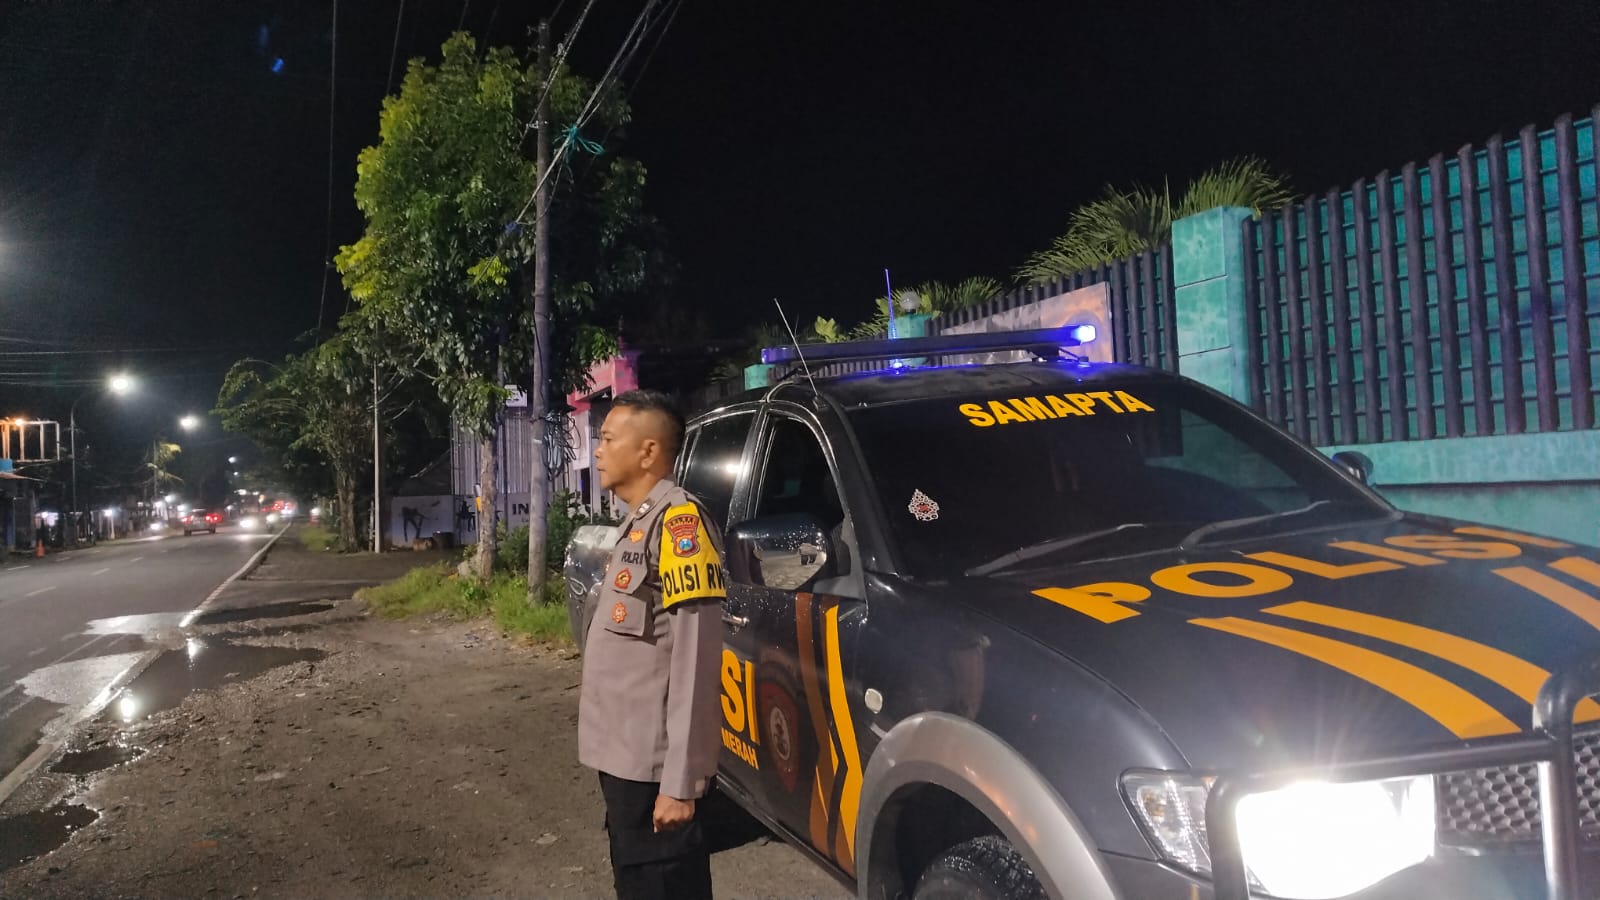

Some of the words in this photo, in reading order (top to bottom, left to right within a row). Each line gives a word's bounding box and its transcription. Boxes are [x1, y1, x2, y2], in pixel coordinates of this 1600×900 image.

[959, 391, 1155, 427] SAMAPTA
[621, 550, 643, 565] POLRI
[1031, 525, 1576, 624] POLISI
